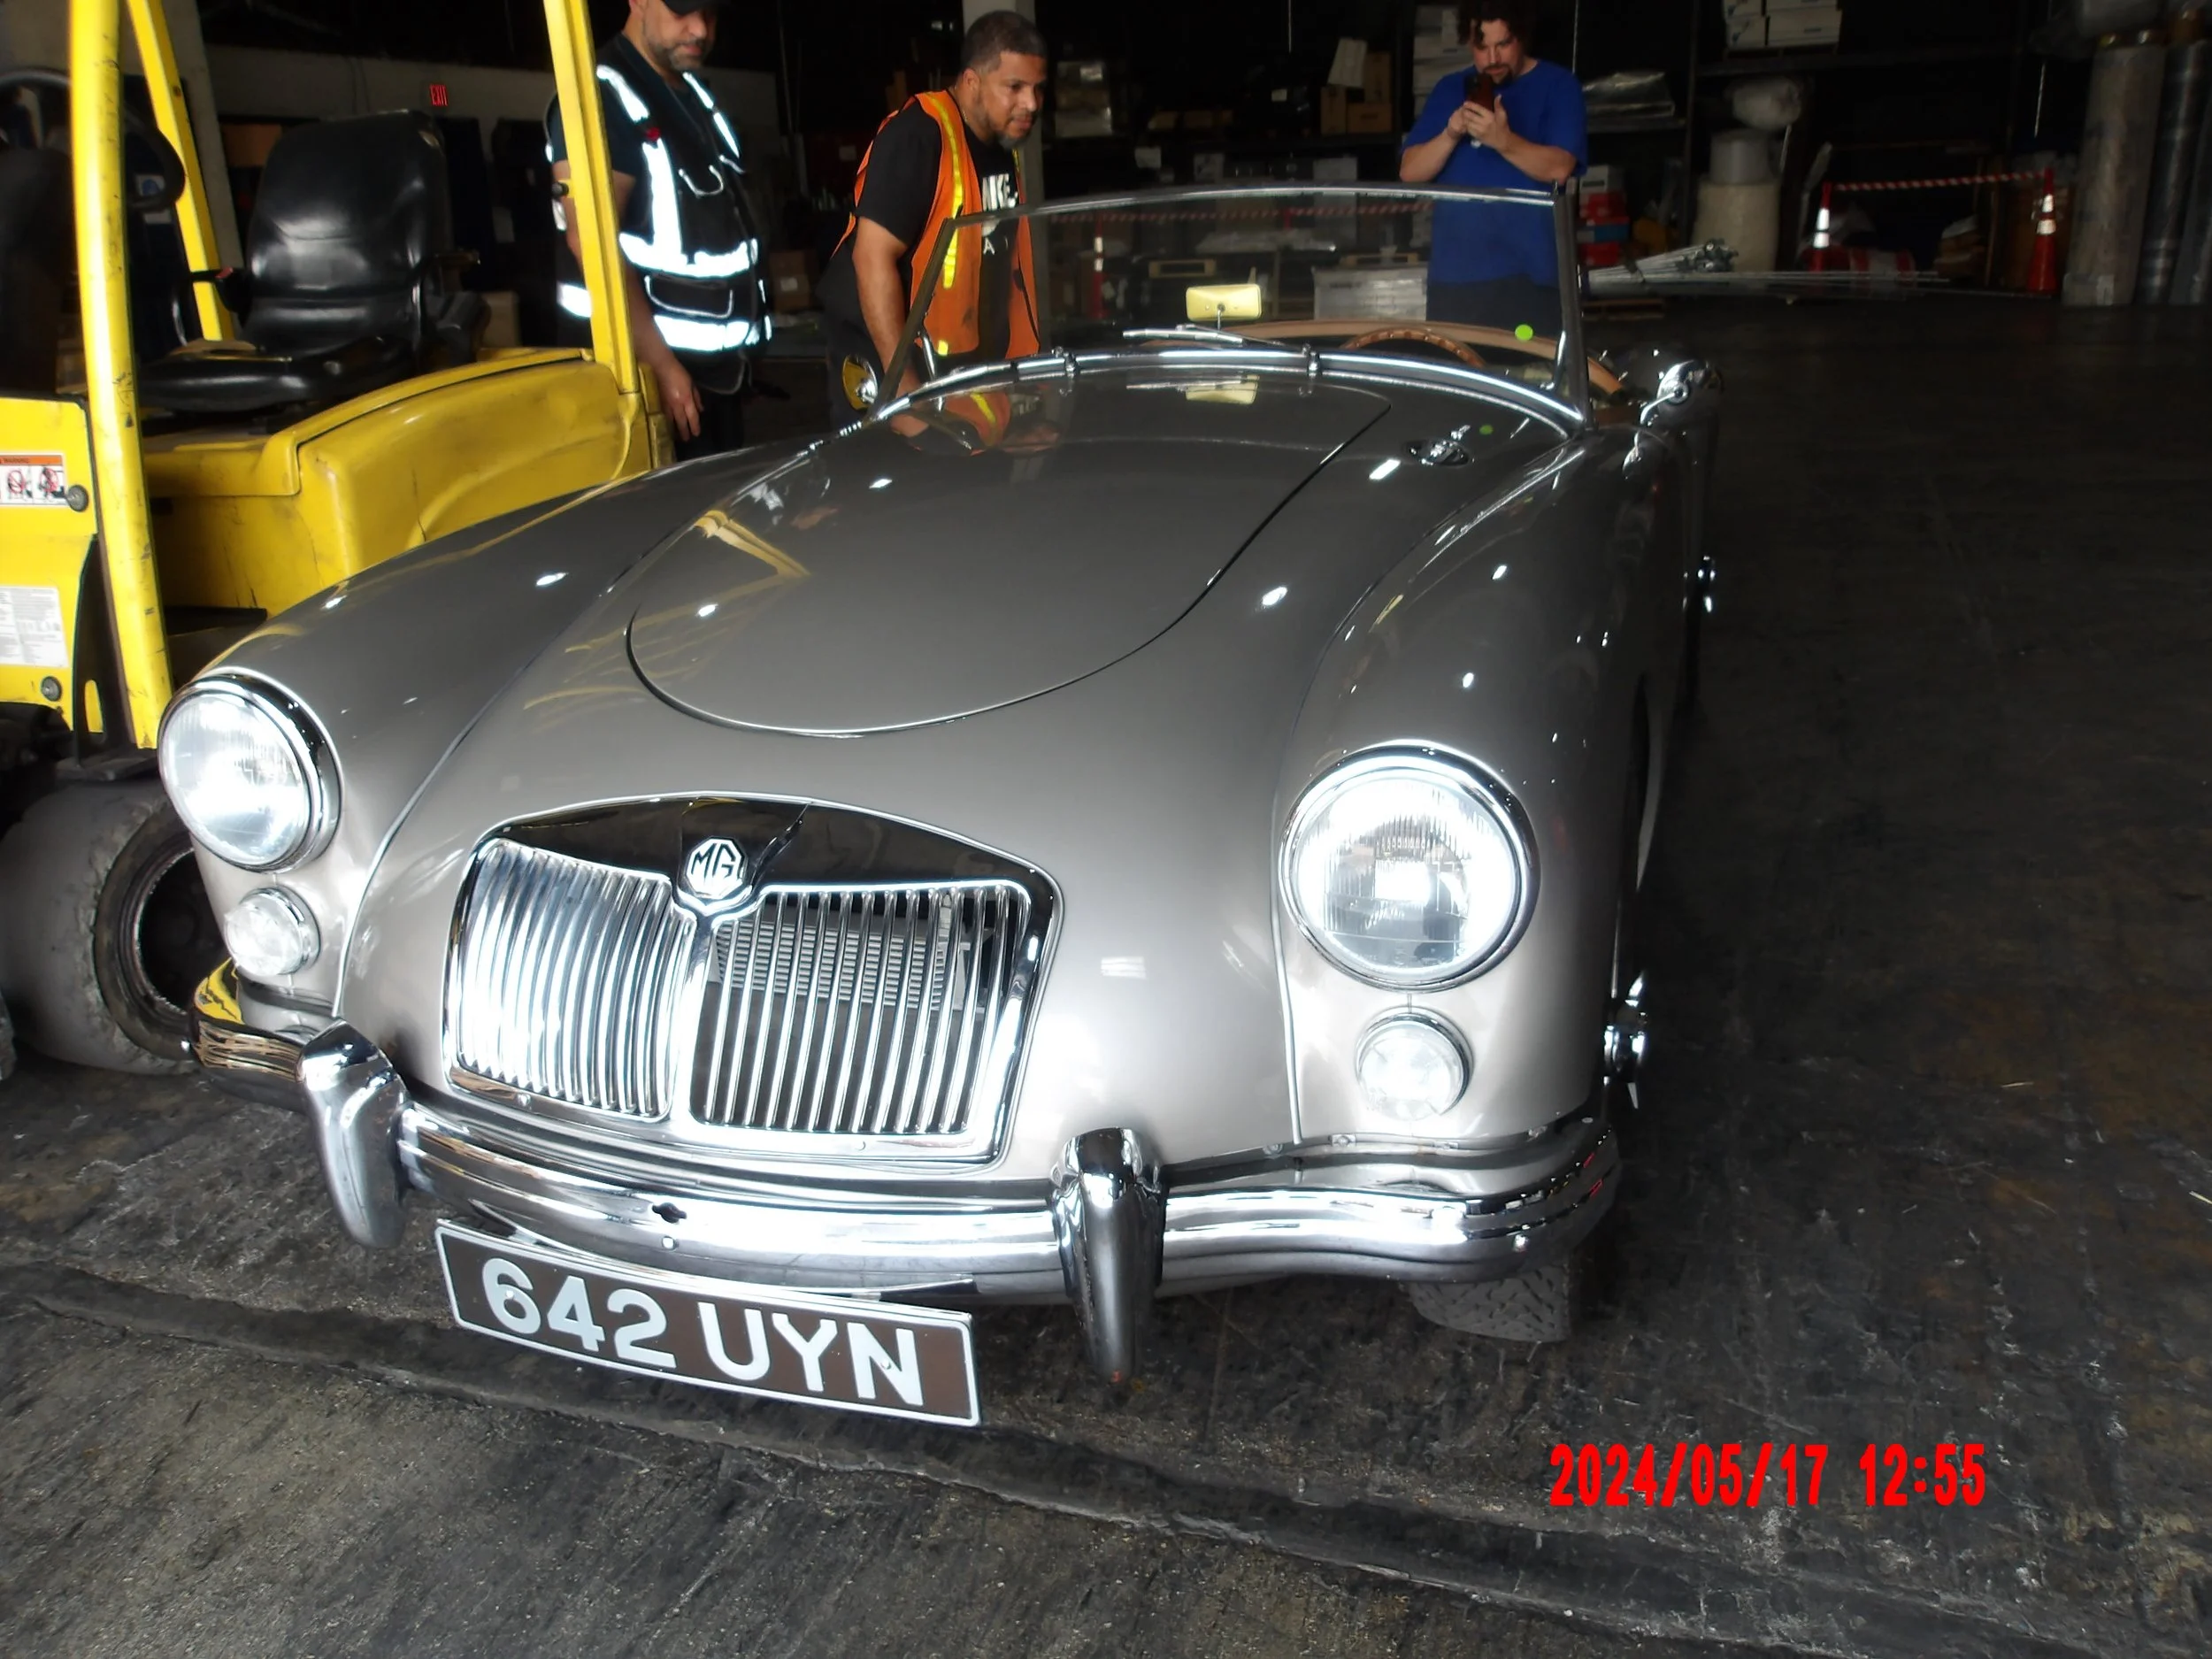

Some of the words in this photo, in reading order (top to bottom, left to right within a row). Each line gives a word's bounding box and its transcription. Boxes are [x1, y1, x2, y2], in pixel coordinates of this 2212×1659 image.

[429, 84, 449, 106] EXIT
[690, 842, 737, 880] MG
[482, 1257, 677, 1369] 642
[697, 1302, 925, 1407] UYN
